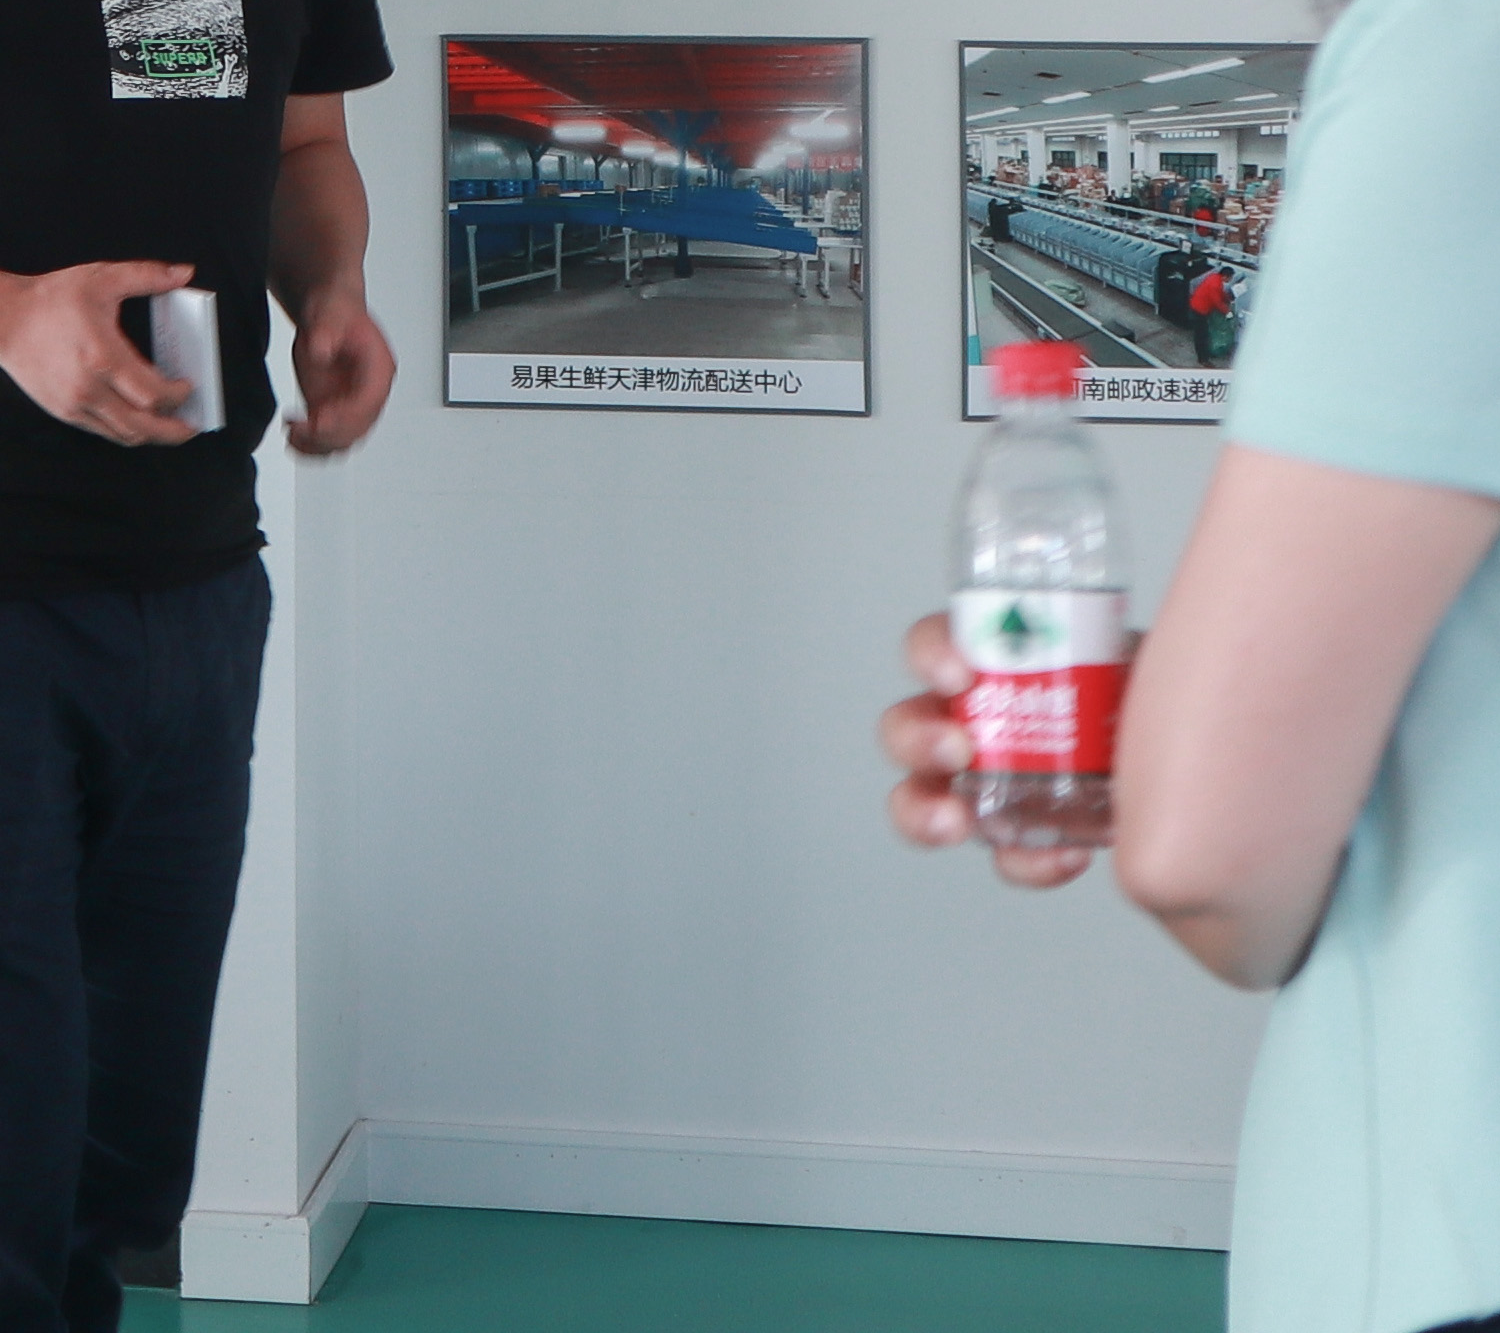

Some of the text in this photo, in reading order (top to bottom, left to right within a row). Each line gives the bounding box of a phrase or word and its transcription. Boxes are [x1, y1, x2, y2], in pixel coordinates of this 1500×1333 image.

[510, 364, 803, 396] 易果生鲜天津物流配送中心
